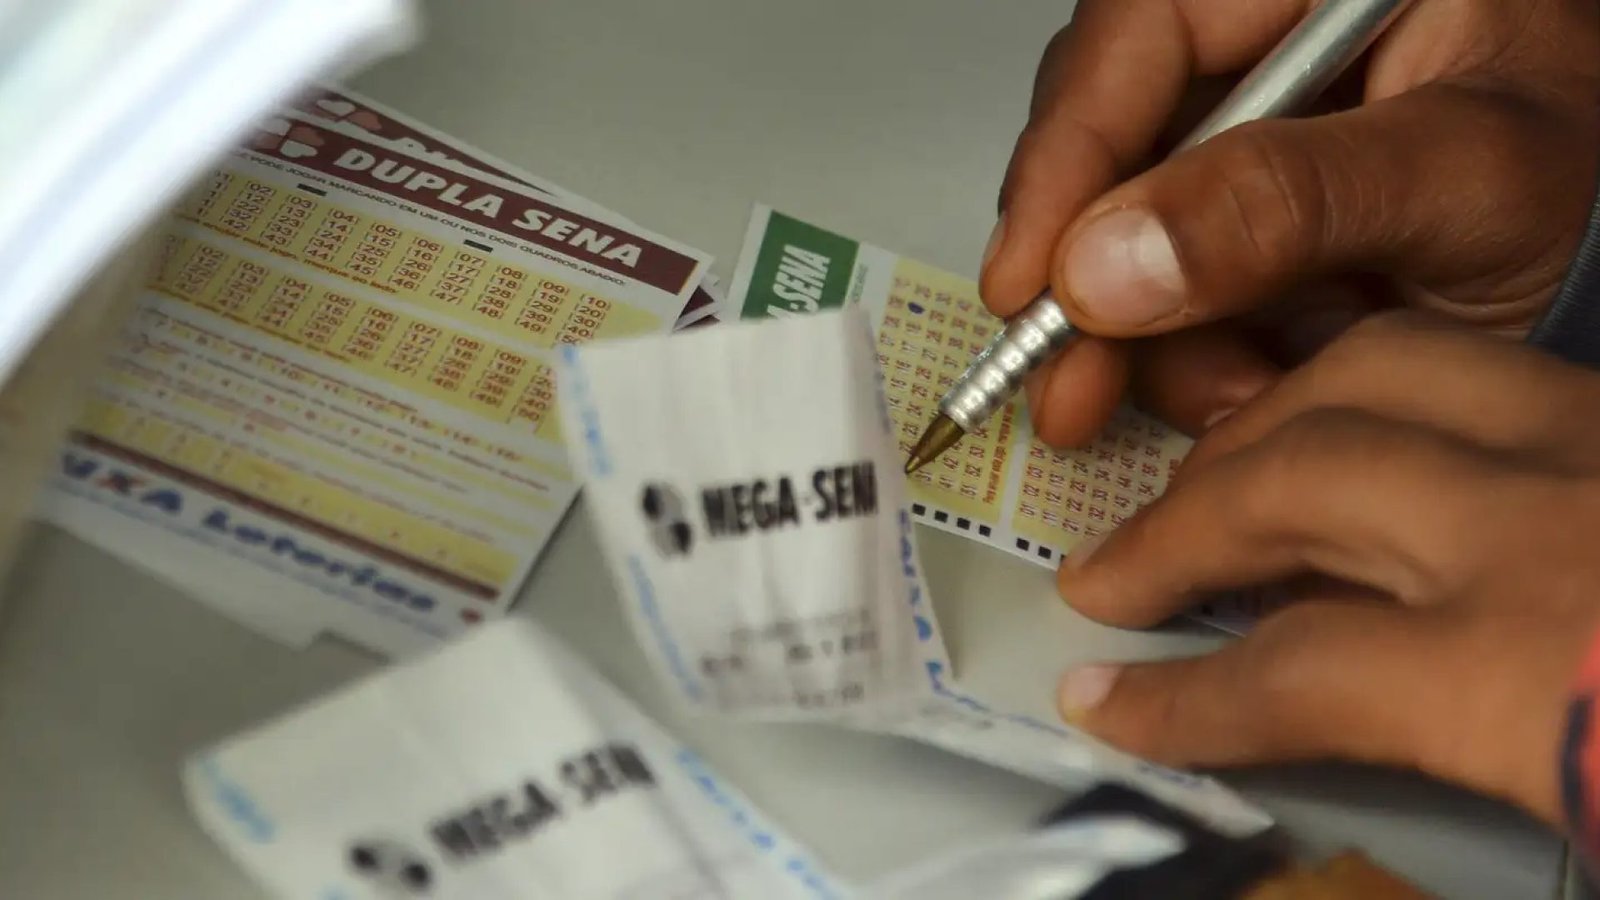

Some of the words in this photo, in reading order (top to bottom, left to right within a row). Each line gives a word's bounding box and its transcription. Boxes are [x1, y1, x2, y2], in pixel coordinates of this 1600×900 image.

[287, 206, 306, 218] 13
[329, 220, 348, 232] 14
[371, 235, 390, 247] 15
[413, 249, 432, 261] 16
[457, 263, 477, 274] 17
[498, 277, 517, 289] 18
[540, 291, 559, 303] 19
[578, 305, 600, 318] 20
[290, 196, 312, 208] 03
[333, 210, 355, 222] 04
[375, 224, 397, 236] 05
[417, 240, 440, 251] 06
[460, 253, 482, 265] 07
[501, 267, 522, 279] 08
[543, 281, 565, 293] 09
[588, 297, 607, 309] 10
[333, 148, 505, 218] DUPLA
[511, 208, 643, 268] SENA
[265, 234, 287, 245] 43
[307, 249, 329, 260] 44
[350, 264, 372, 275] 45
[392, 278, 415, 290] 46
[434, 291, 457, 303] 47
[477, 306, 499, 318] 48
[519, 321, 541, 332] 49
[270, 223, 292, 236] 33
[356, 253, 377, 265] 35
[399, 268, 421, 280] 36
[441, 281, 463, 293] 37
[526, 310, 547, 322] 39
[567, 326, 589, 337] 40
[278, 215, 300, 227] 23
[320, 230, 342, 242] 24
[405, 259, 427, 271] 26
[447, 272, 470, 284] 27
[488, 286, 511, 299] 28
[530, 301, 553, 312] 29
[573, 315, 595, 328] 30
